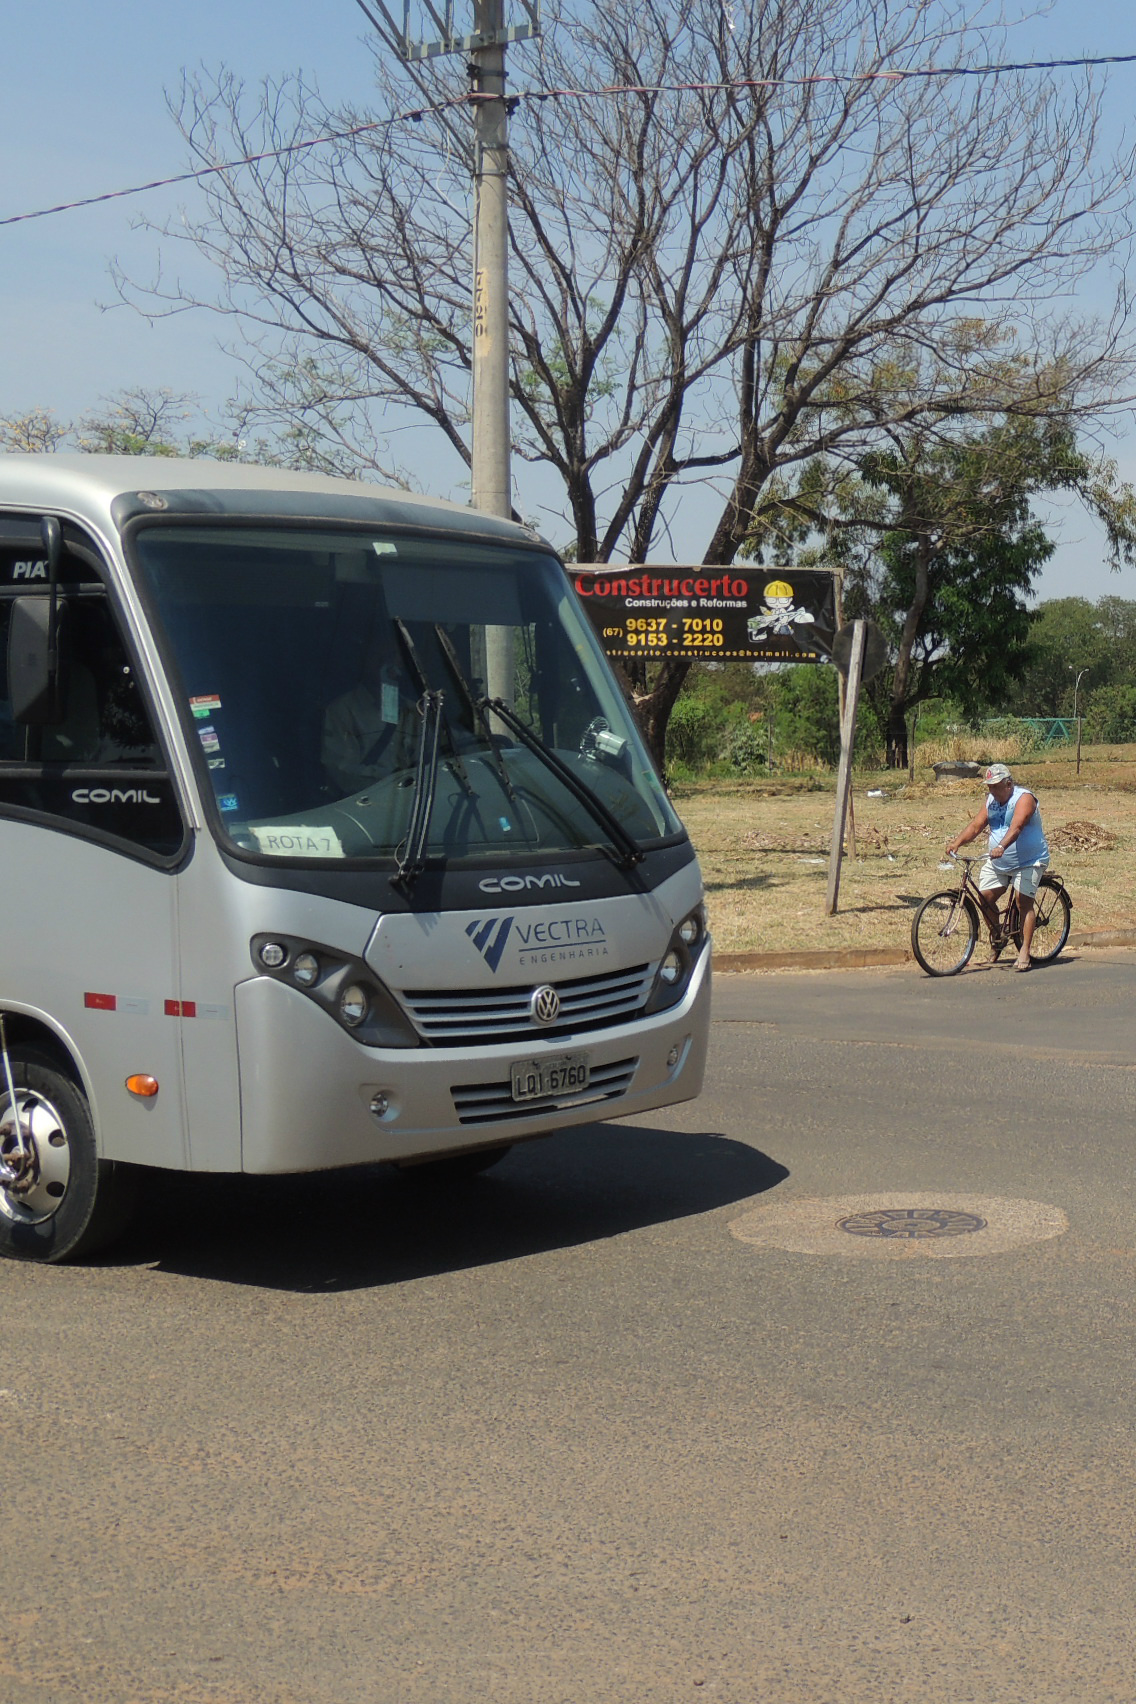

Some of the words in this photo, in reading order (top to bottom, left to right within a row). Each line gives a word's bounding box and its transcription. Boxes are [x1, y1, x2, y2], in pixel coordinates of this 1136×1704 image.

[574, 573, 749, 598] Construcerto
[625, 597, 689, 609] Construções
[691, 599, 697, 607] e
[700, 597, 748, 608] Reformas
[602, 627, 623, 638] (67)
[625, 618, 668, 632] 9637
[682, 618, 723, 631] 7010
[626, 633, 668, 647] 9153
[682, 633, 724, 647] 2220
[71, 787, 161, 805] COMIL
[268, 832, 319, 852] ROTA
[320, 838, 332, 853] 7
[478, 872, 581, 895] COMIL
[515, 917, 606, 944] VECTRA
[518, 946, 610, 966] ENGENHARIA
